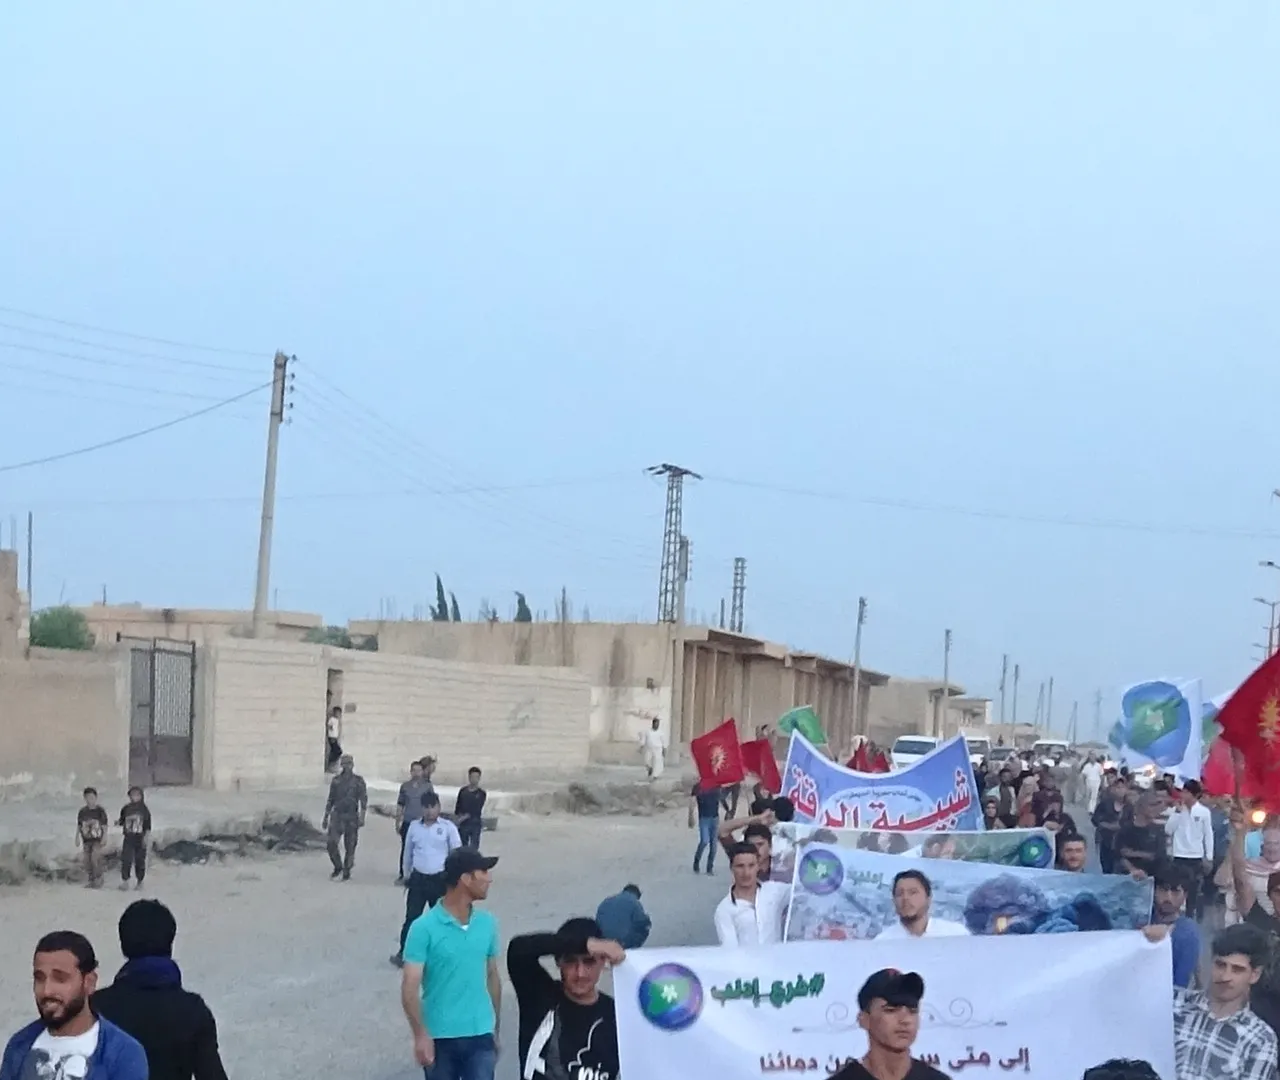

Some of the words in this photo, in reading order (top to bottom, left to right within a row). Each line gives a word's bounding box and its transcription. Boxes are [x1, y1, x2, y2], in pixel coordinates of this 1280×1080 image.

[760, 1050, 818, 1074] دمائنا
[948, 1045, 991, 1070] متى
[998, 1047, 1031, 1072] إلى
